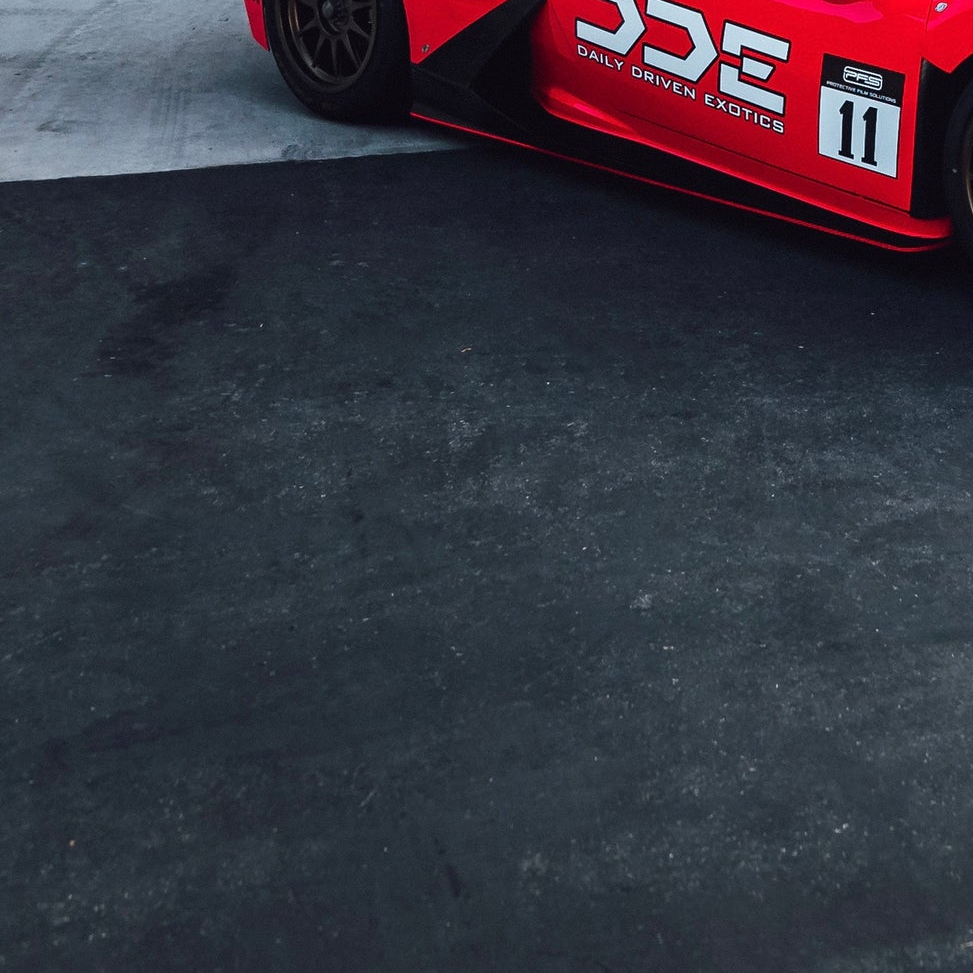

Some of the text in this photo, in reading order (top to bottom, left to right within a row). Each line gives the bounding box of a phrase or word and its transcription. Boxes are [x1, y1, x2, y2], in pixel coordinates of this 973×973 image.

[577, 44, 785, 134] DAILY DRIVEN EXOTICS
[826, 80, 897, 104] PROTECTIVE FILM SOLUTIONS
[844, 68, 882, 88] PFS
[838, 99, 878, 167] 11
